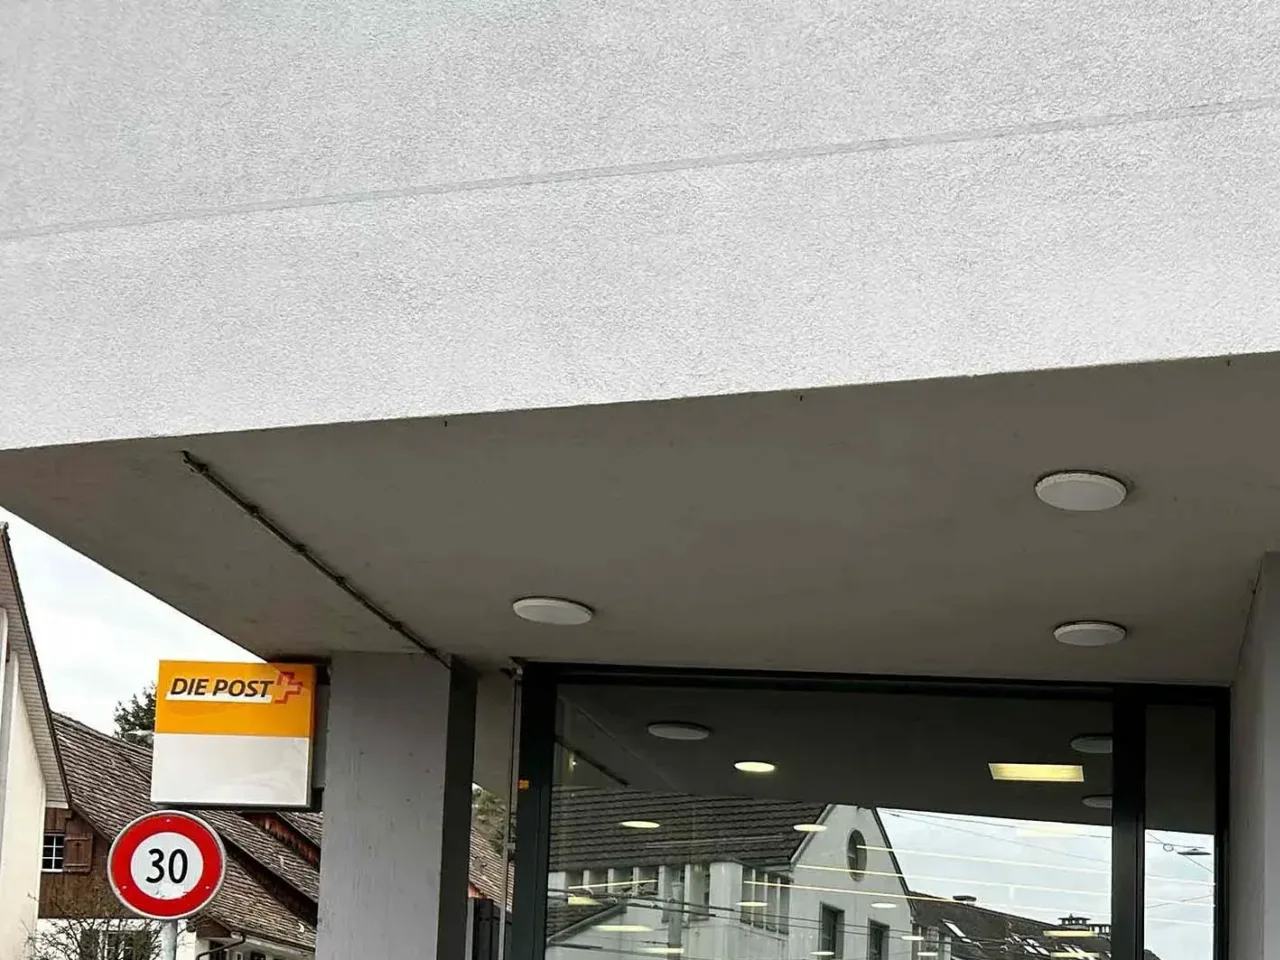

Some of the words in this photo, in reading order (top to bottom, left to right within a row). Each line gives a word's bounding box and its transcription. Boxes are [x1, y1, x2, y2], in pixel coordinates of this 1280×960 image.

[170, 678, 209, 695] DIE
[212, 679, 274, 697] POST
[146, 849, 188, 884] 30
